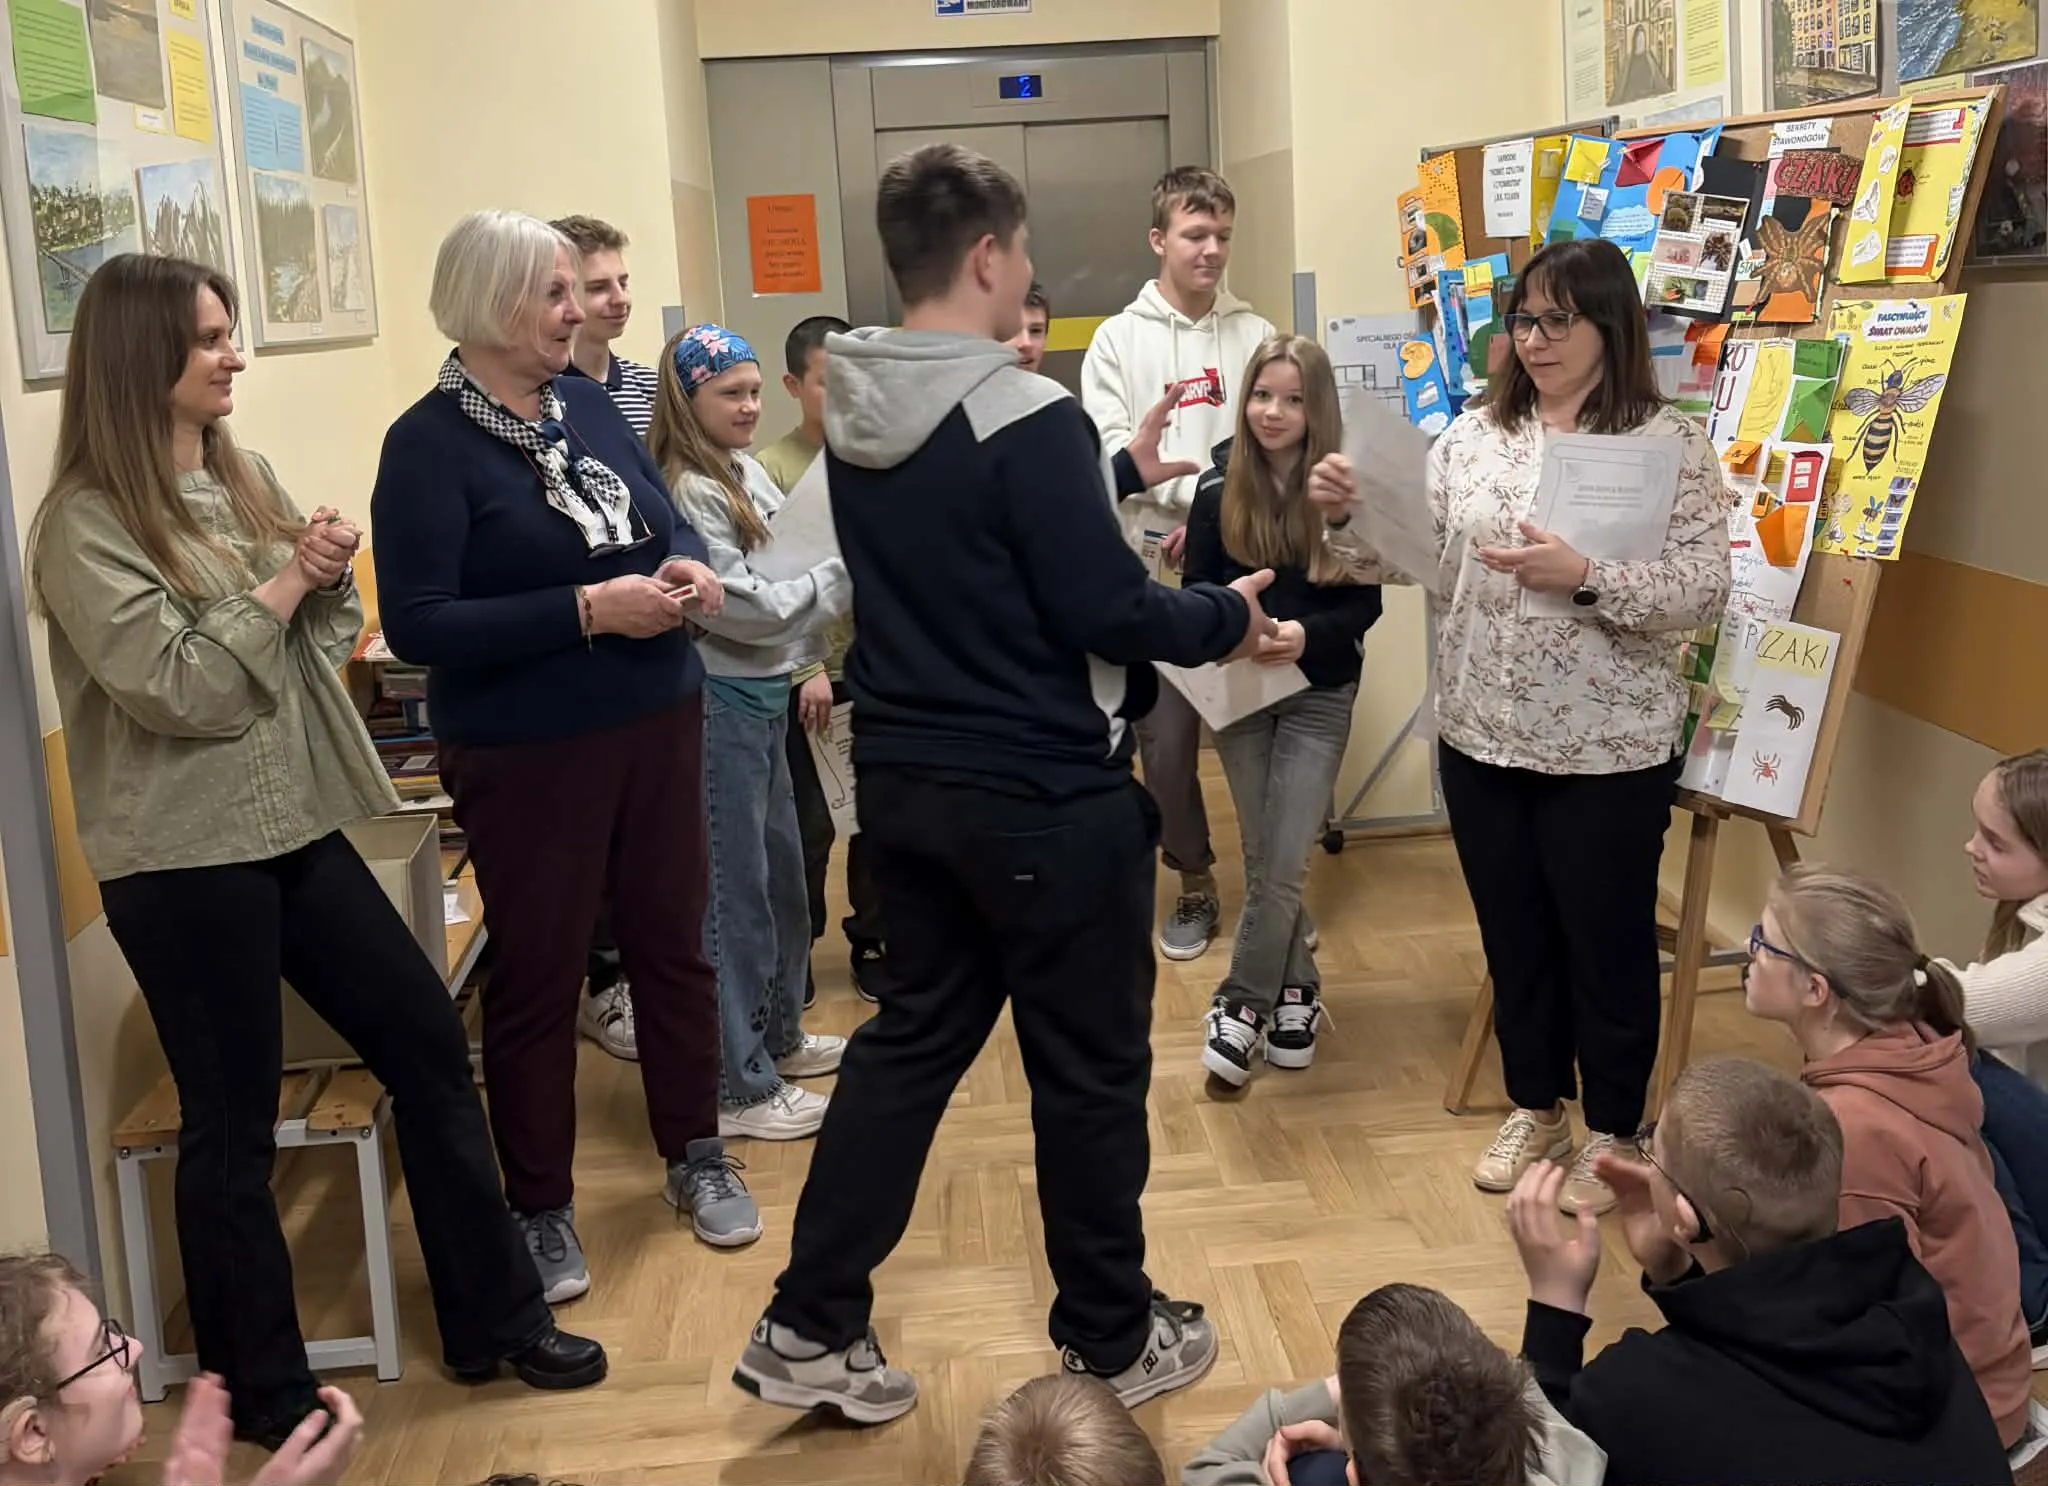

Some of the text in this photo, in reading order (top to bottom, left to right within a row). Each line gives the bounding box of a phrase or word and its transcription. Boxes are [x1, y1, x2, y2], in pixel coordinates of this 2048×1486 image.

[1786, 122, 1816, 132] SEKRETY
[1774, 159, 1858, 195] CZAKI
[1877, 311, 1927, 322] FASCYNUJĄCY
[1868, 324, 1928, 336] ŚWIAT OWADÓW
[1756, 629, 1829, 669] CZAKI
